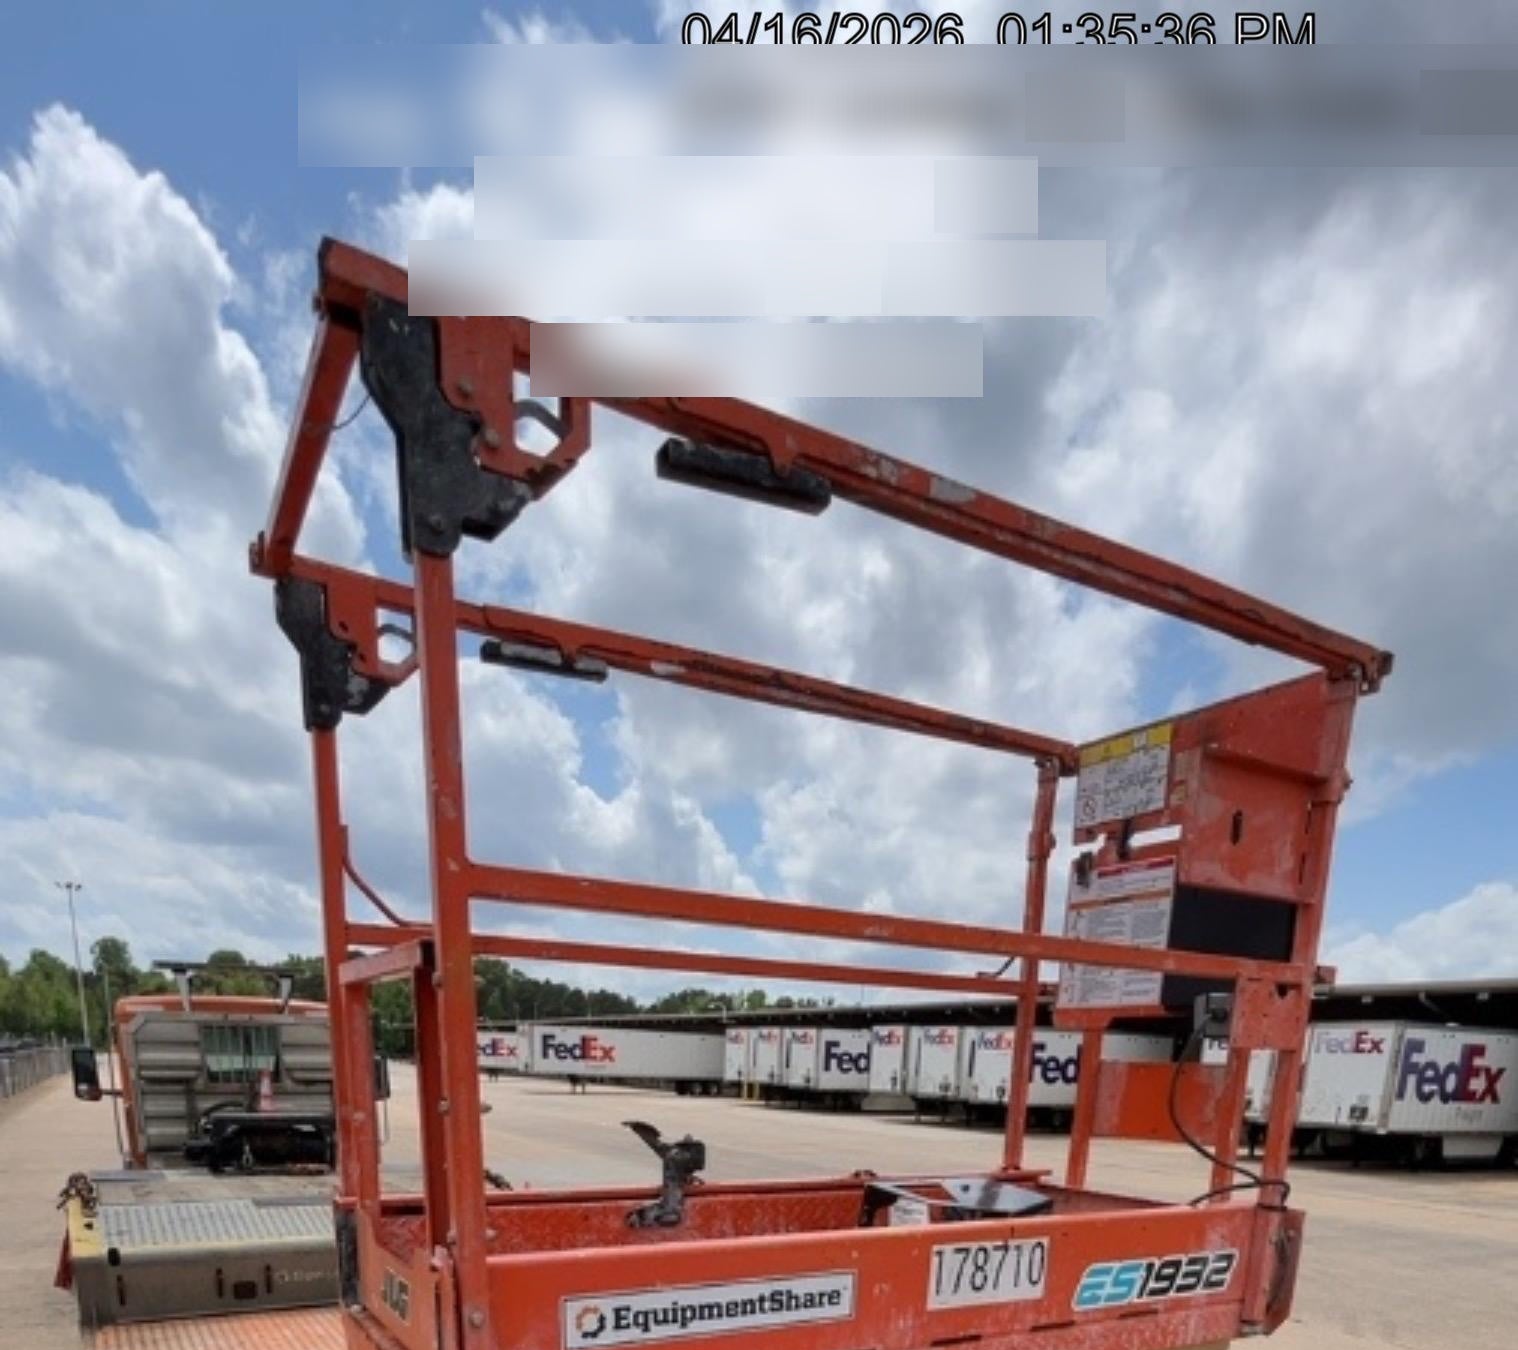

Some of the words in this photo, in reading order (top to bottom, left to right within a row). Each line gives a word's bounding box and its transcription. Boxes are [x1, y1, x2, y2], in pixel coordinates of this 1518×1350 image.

[542, 1034, 616, 1063] FedEx
[823, 1040, 871, 1074] Fed
[1028, 1042, 1082, 1084] Fed
[1314, 1031, 1385, 1054] FedEx
[1396, 1037, 1507, 1105] FedEx
[934, 1241, 1046, 1297] 178710
[1073, 1252, 1236, 1307] ES1932
[612, 1288, 842, 1333] EquipmentShare
